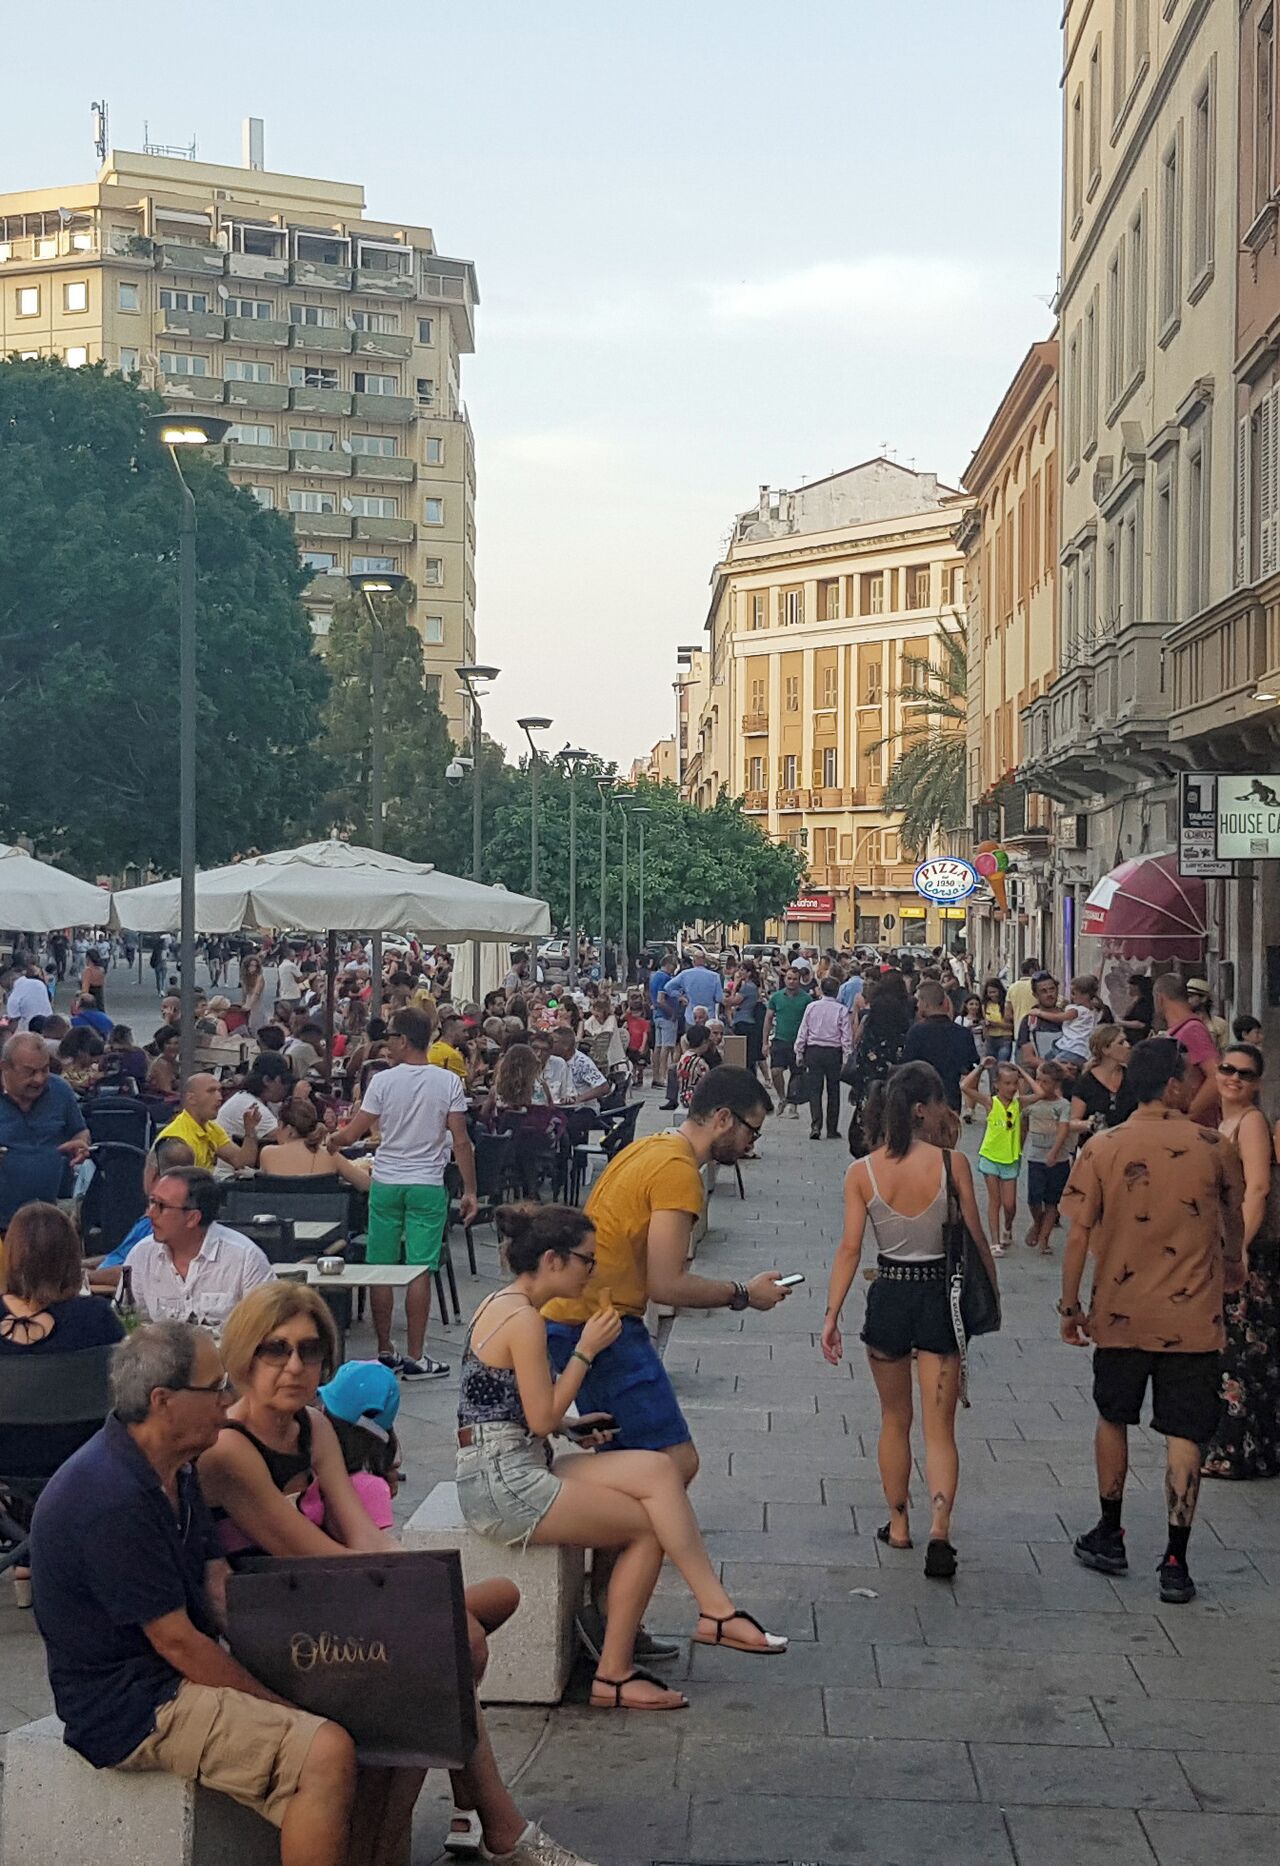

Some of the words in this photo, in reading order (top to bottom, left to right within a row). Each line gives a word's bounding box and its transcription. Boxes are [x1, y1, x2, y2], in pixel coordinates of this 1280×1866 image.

[1220, 813, 1263, 834] HOUSE
[922, 863, 969, 881] PIZZA
[290, 1631, 388, 1671] Olivia
